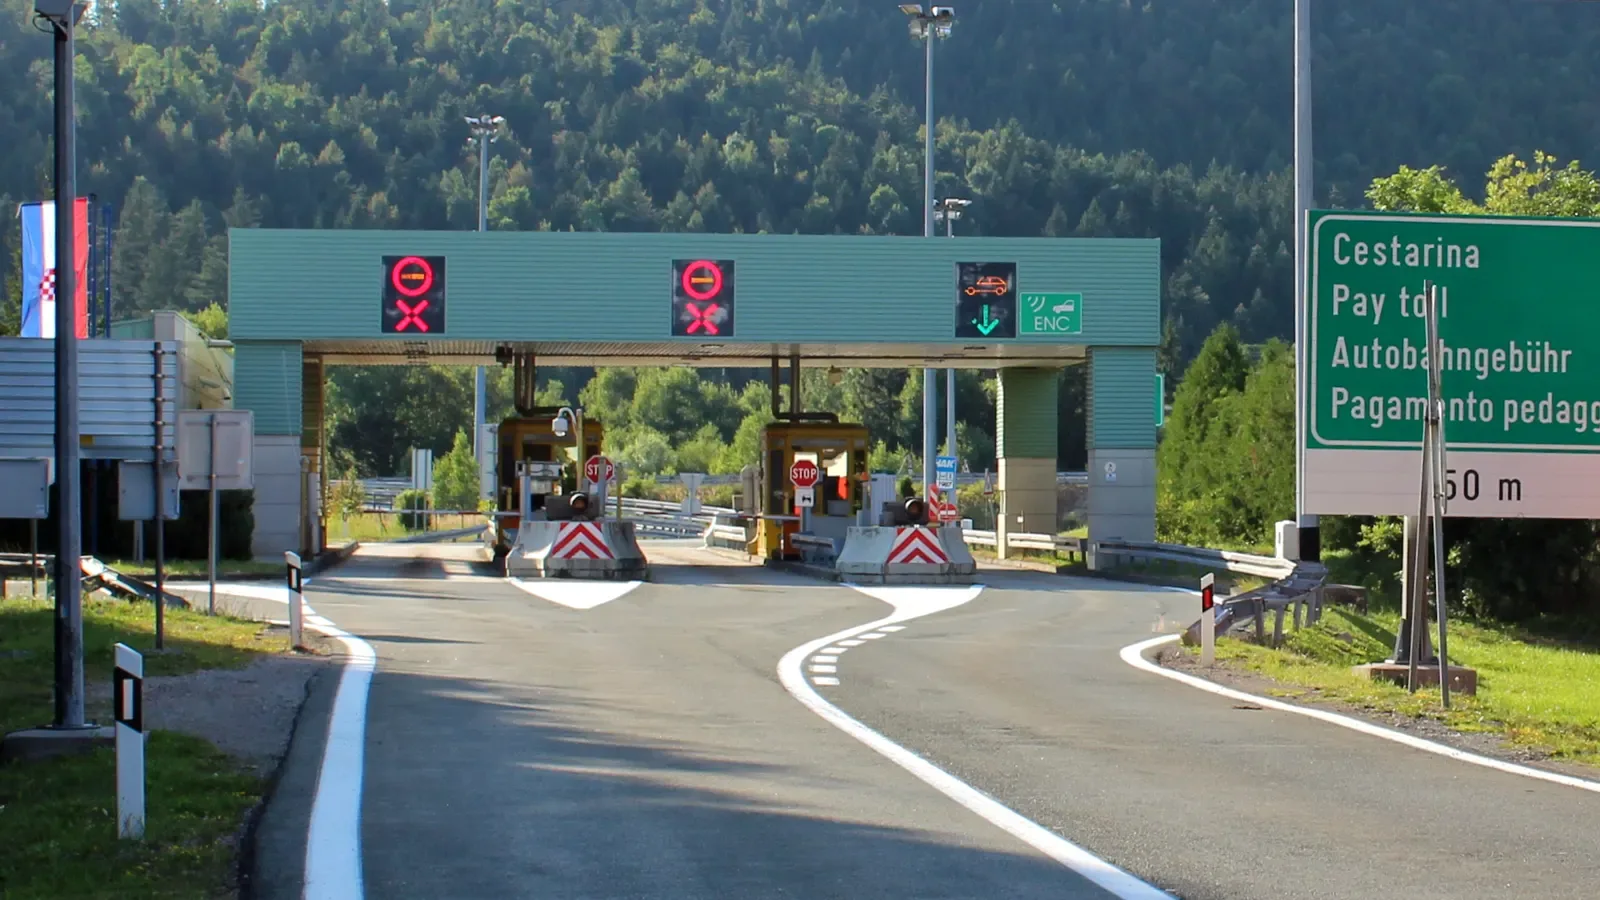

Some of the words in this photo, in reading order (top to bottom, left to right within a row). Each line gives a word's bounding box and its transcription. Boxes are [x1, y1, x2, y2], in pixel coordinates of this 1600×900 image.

[1333, 232, 1480, 269] Cestarina
[1332, 284, 1386, 325] Pay
[1399, 286, 1448, 318] tol
[1034, 315, 1071, 331] ENC
[587, 464, 612, 476] STP
[792, 467, 817, 479] STOP
[1498, 478, 1521, 501] m
